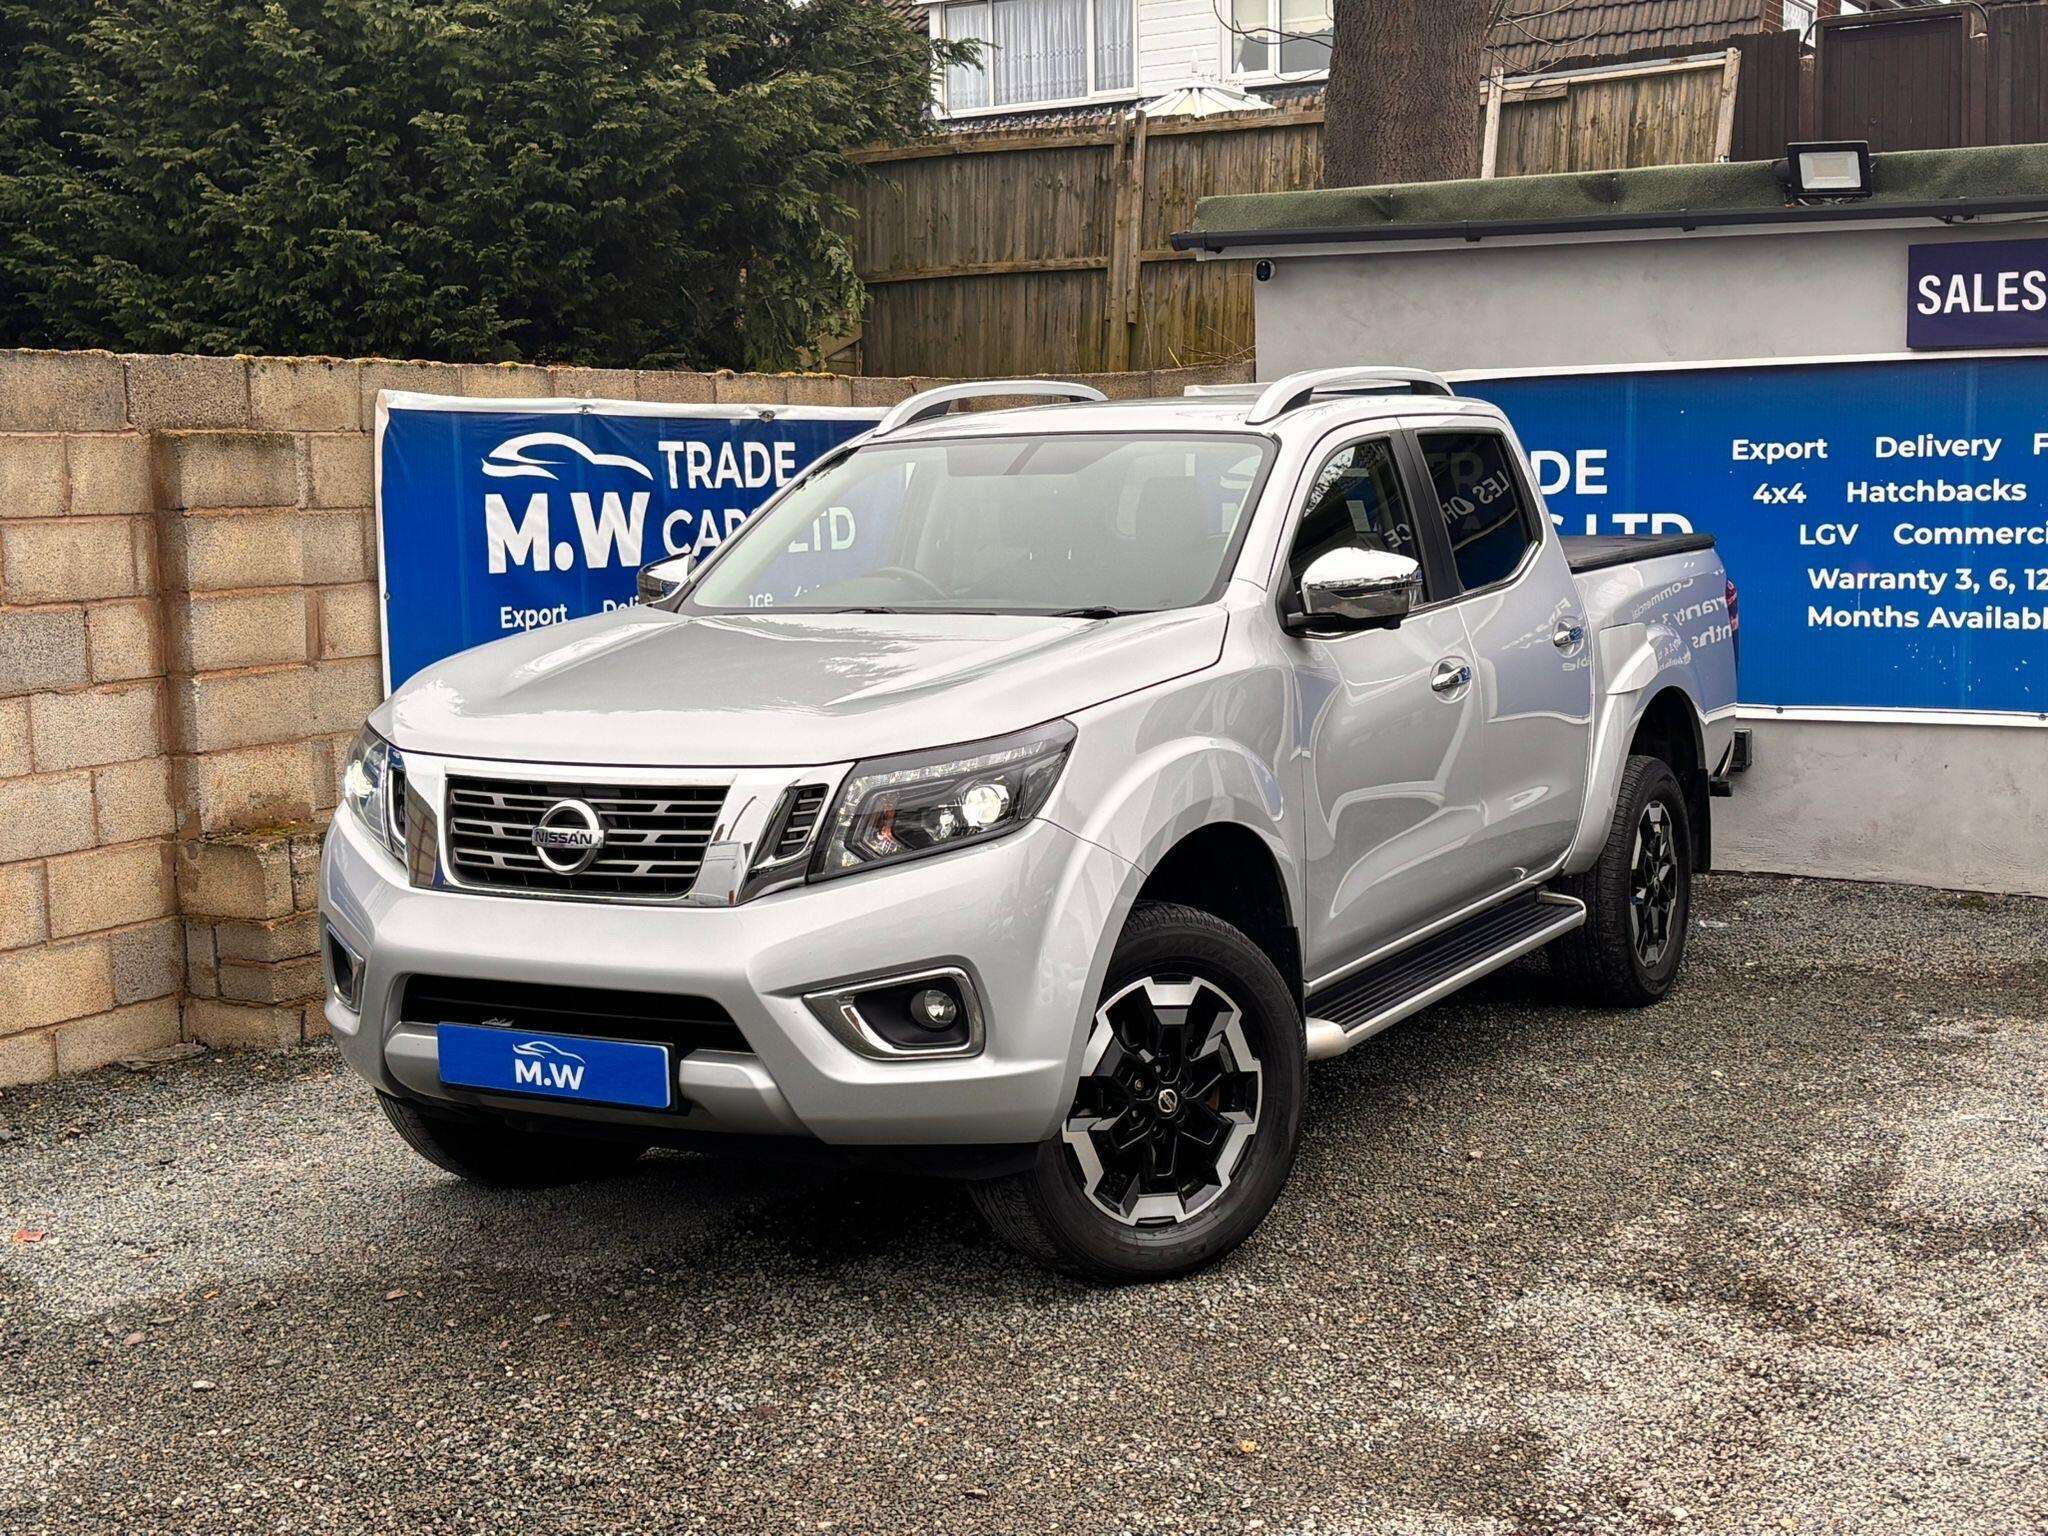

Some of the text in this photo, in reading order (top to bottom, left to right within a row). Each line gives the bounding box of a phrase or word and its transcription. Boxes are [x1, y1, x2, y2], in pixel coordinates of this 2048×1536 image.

[1917, 270, 2047, 315] SALES
[1732, 437, 1828, 464] Export
[1875, 434, 2002, 461] Delivery
[658, 441, 796, 489] TRADE
[1753, 479, 2028, 504] 4x4 Hatchbacks
[485, 491, 651, 574] M.W
[1800, 523, 1859, 546] LGV
[1807, 568, 1948, 595] Warranty
[1955, 568, 1981, 595] 3,
[1989, 568, 2017, 595] 6,
[500, 603, 568, 631] Export
[1807, 606, 2048, 630] Months Availabl
[534, 830, 593, 845] NISSAN
[514, 1058, 586, 1090] M.W
